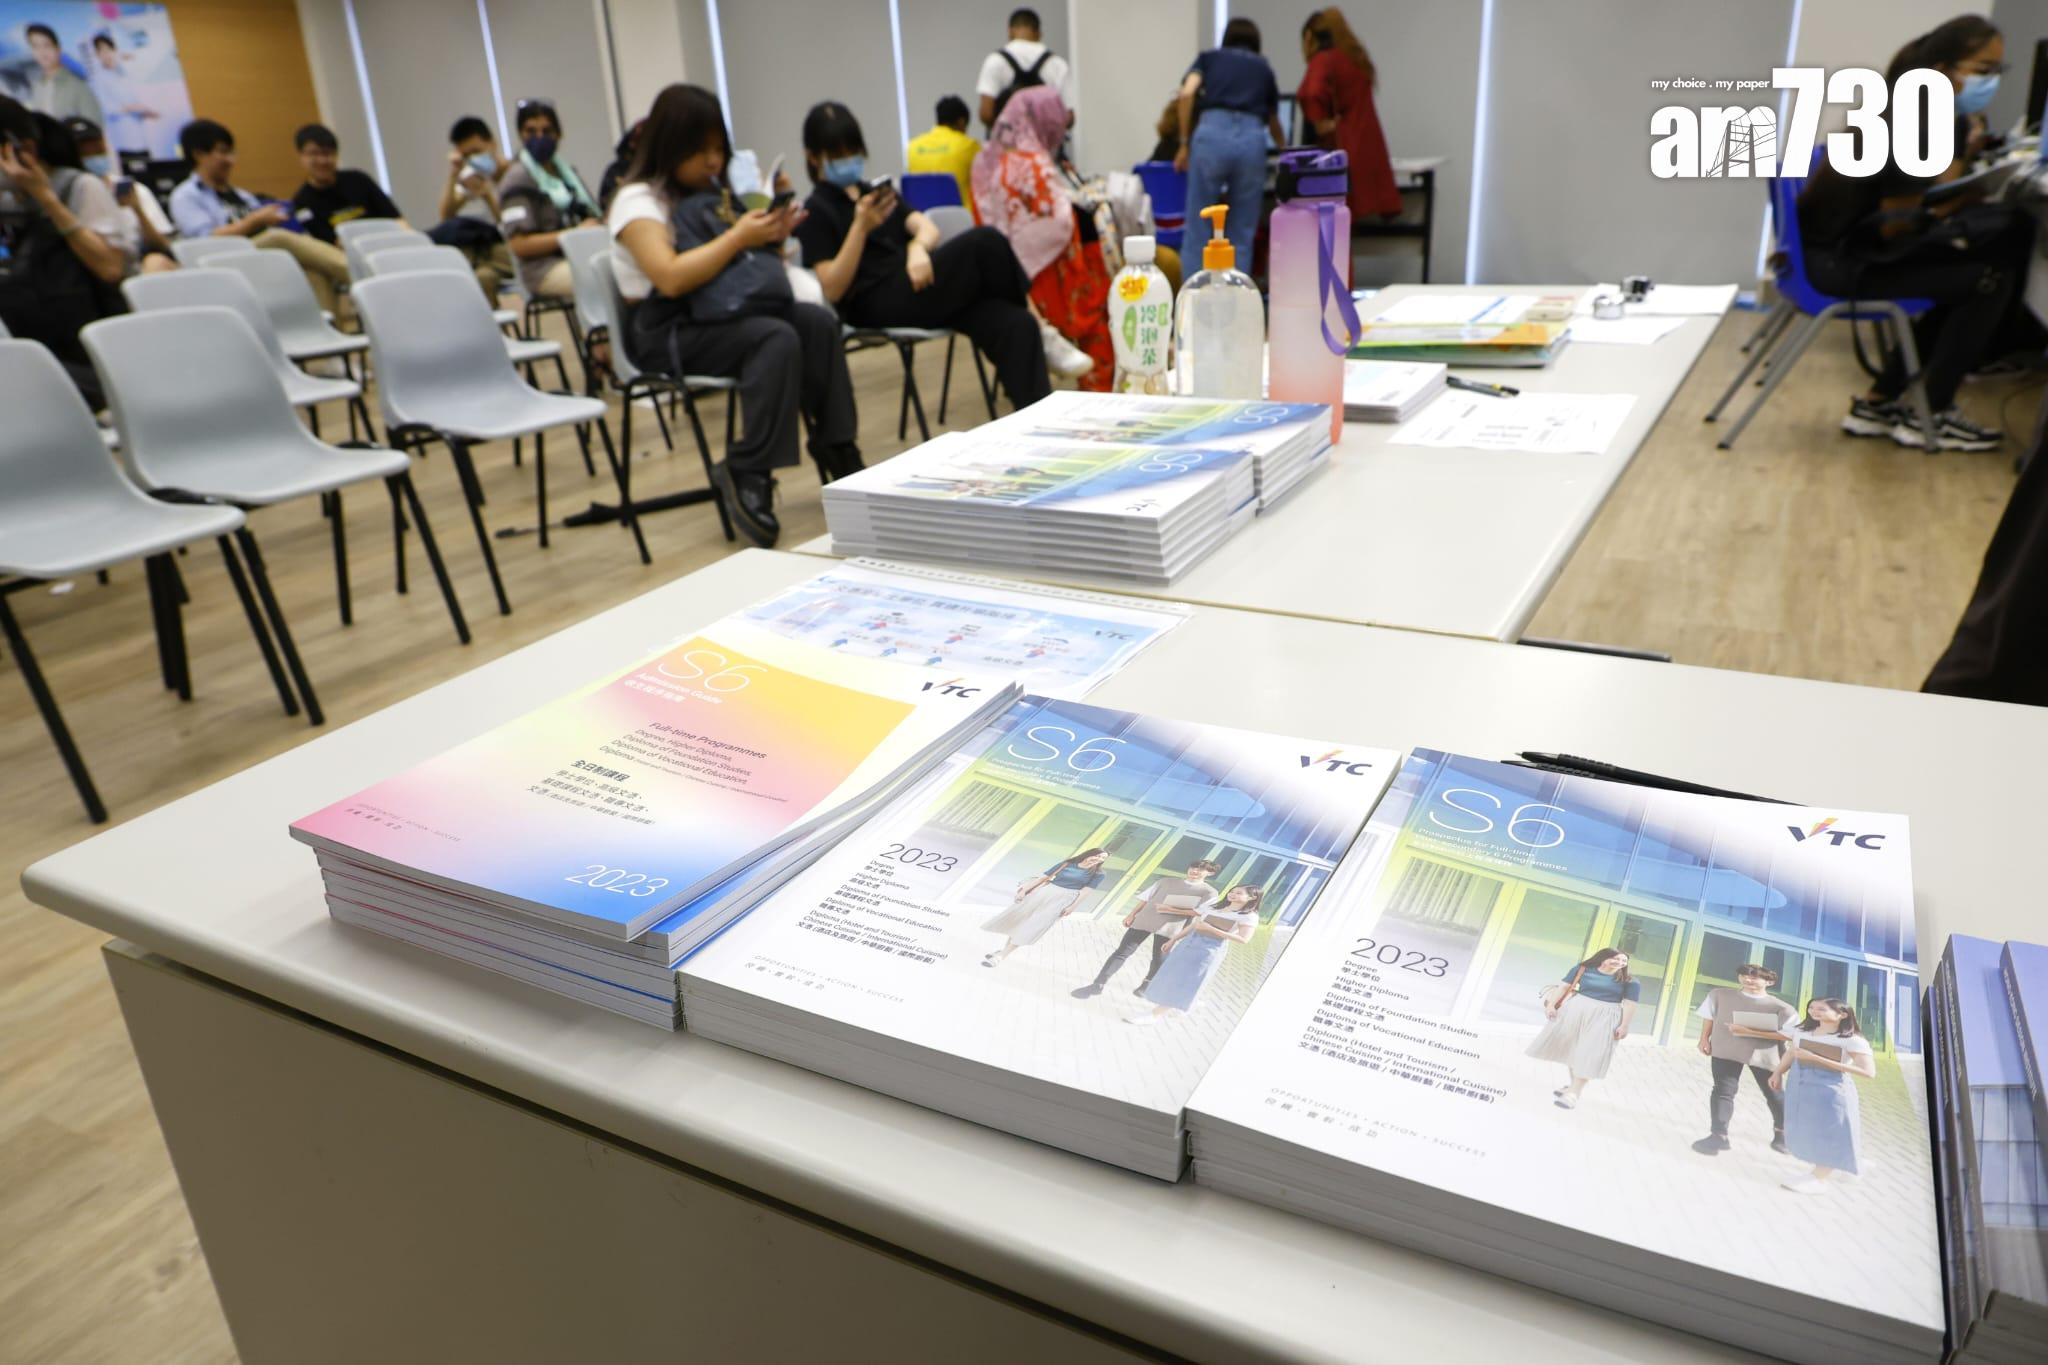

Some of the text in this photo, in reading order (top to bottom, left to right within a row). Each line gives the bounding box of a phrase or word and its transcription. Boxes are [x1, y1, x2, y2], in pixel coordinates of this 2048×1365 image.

[657, 649, 768, 693] S6
[921, 677, 982, 699] VTC
[649, 722, 768, 760] Full-time Programmes
[1006, 725, 1128, 772] S6
[1300, 748, 1373, 776] VTC
[1428, 788, 1566, 848] S6
[1786, 816, 1886, 850] VTC
[879, 843, 958, 872] 2023
[564, 864, 669, 897] 2023
[855, 872, 910, 890] Higher Diploma
[825, 896, 856, 909] Diploma
[865, 908, 905, 923] Vocational
[904, 918, 943, 933] Education
[840, 884, 871, 897] Diploma
[879, 895, 921, 910] Foundation
[921, 905, 950, 917] Studies
[803, 915, 833, 928] Chinese
[833, 924, 861, 936] Cuisine
[866, 933, 916, 951] International
[809, 909, 841, 922] Diploma
[863, 925, 881, 933] and
[880, 929, 911, 943] Tourism
[1344, 959, 1378, 974] Degree
[1350, 937, 1448, 979] 2023
[1335, 975, 1409, 1001] Higher Diploma
[1326, 991, 1367, 1009] Diploma
[1380, 1006, 1438, 1028] Foundation
[1439, 1022, 1479, 1039] Studies
[1306, 1024, 1348, 1043] Diploma
[1350, 1038, 1382, 1053] (Hotel
[1383, 1049, 1404, 1060] and
[1405, 1053, 1449, 1073] Tourism
[1316, 1007, 1358, 1026] Diploma
[1372, 1024, 1427, 1045] Vocational
[1427, 1039, 1481, 1060] Education
[1302, 1032, 1343, 1050] Chinese
[1344, 1045, 1383, 1063] Cuisine
[1392, 1060, 1461, 1083] International
[1462, 1079, 1508, 1098] Cuisine)
